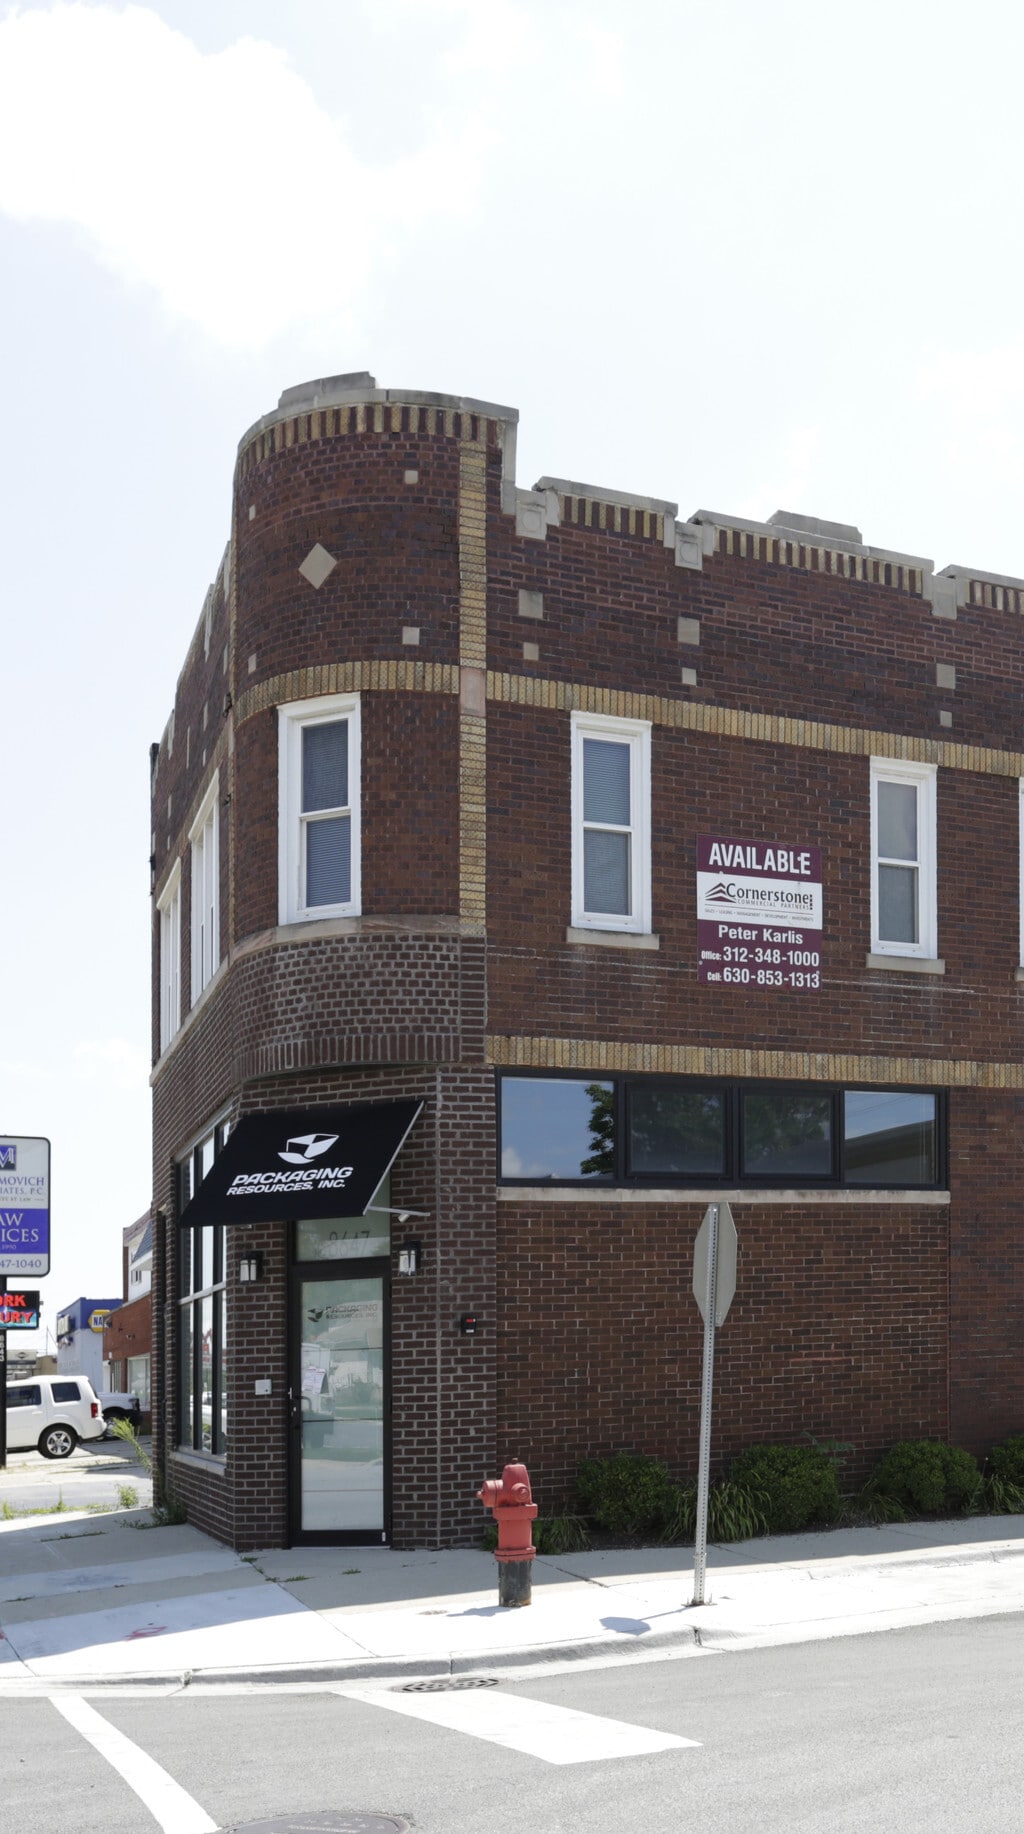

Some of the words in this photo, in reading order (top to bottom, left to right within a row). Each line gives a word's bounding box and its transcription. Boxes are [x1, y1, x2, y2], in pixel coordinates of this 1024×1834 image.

[709, 843, 811, 875] AVAILABLE
[726, 883, 809, 904] Cornerstone
[737, 899, 776, 908] COMMERCIAL
[780, 903, 810, 911] PARTNERS
[718, 924, 758, 941] Peter
[763, 928, 803, 945] Karlis
[701, 950, 722, 961] Office:
[723, 946, 820, 967] 312-348-1000
[707, 972, 722, 982] Cell:
[723, 967, 820, 989] 630-853-1313
[232, 1166, 354, 1186] PACKAGING
[226, 1181, 314, 1196] RESOURCES,
[317, 1179, 346, 1189] INC.
